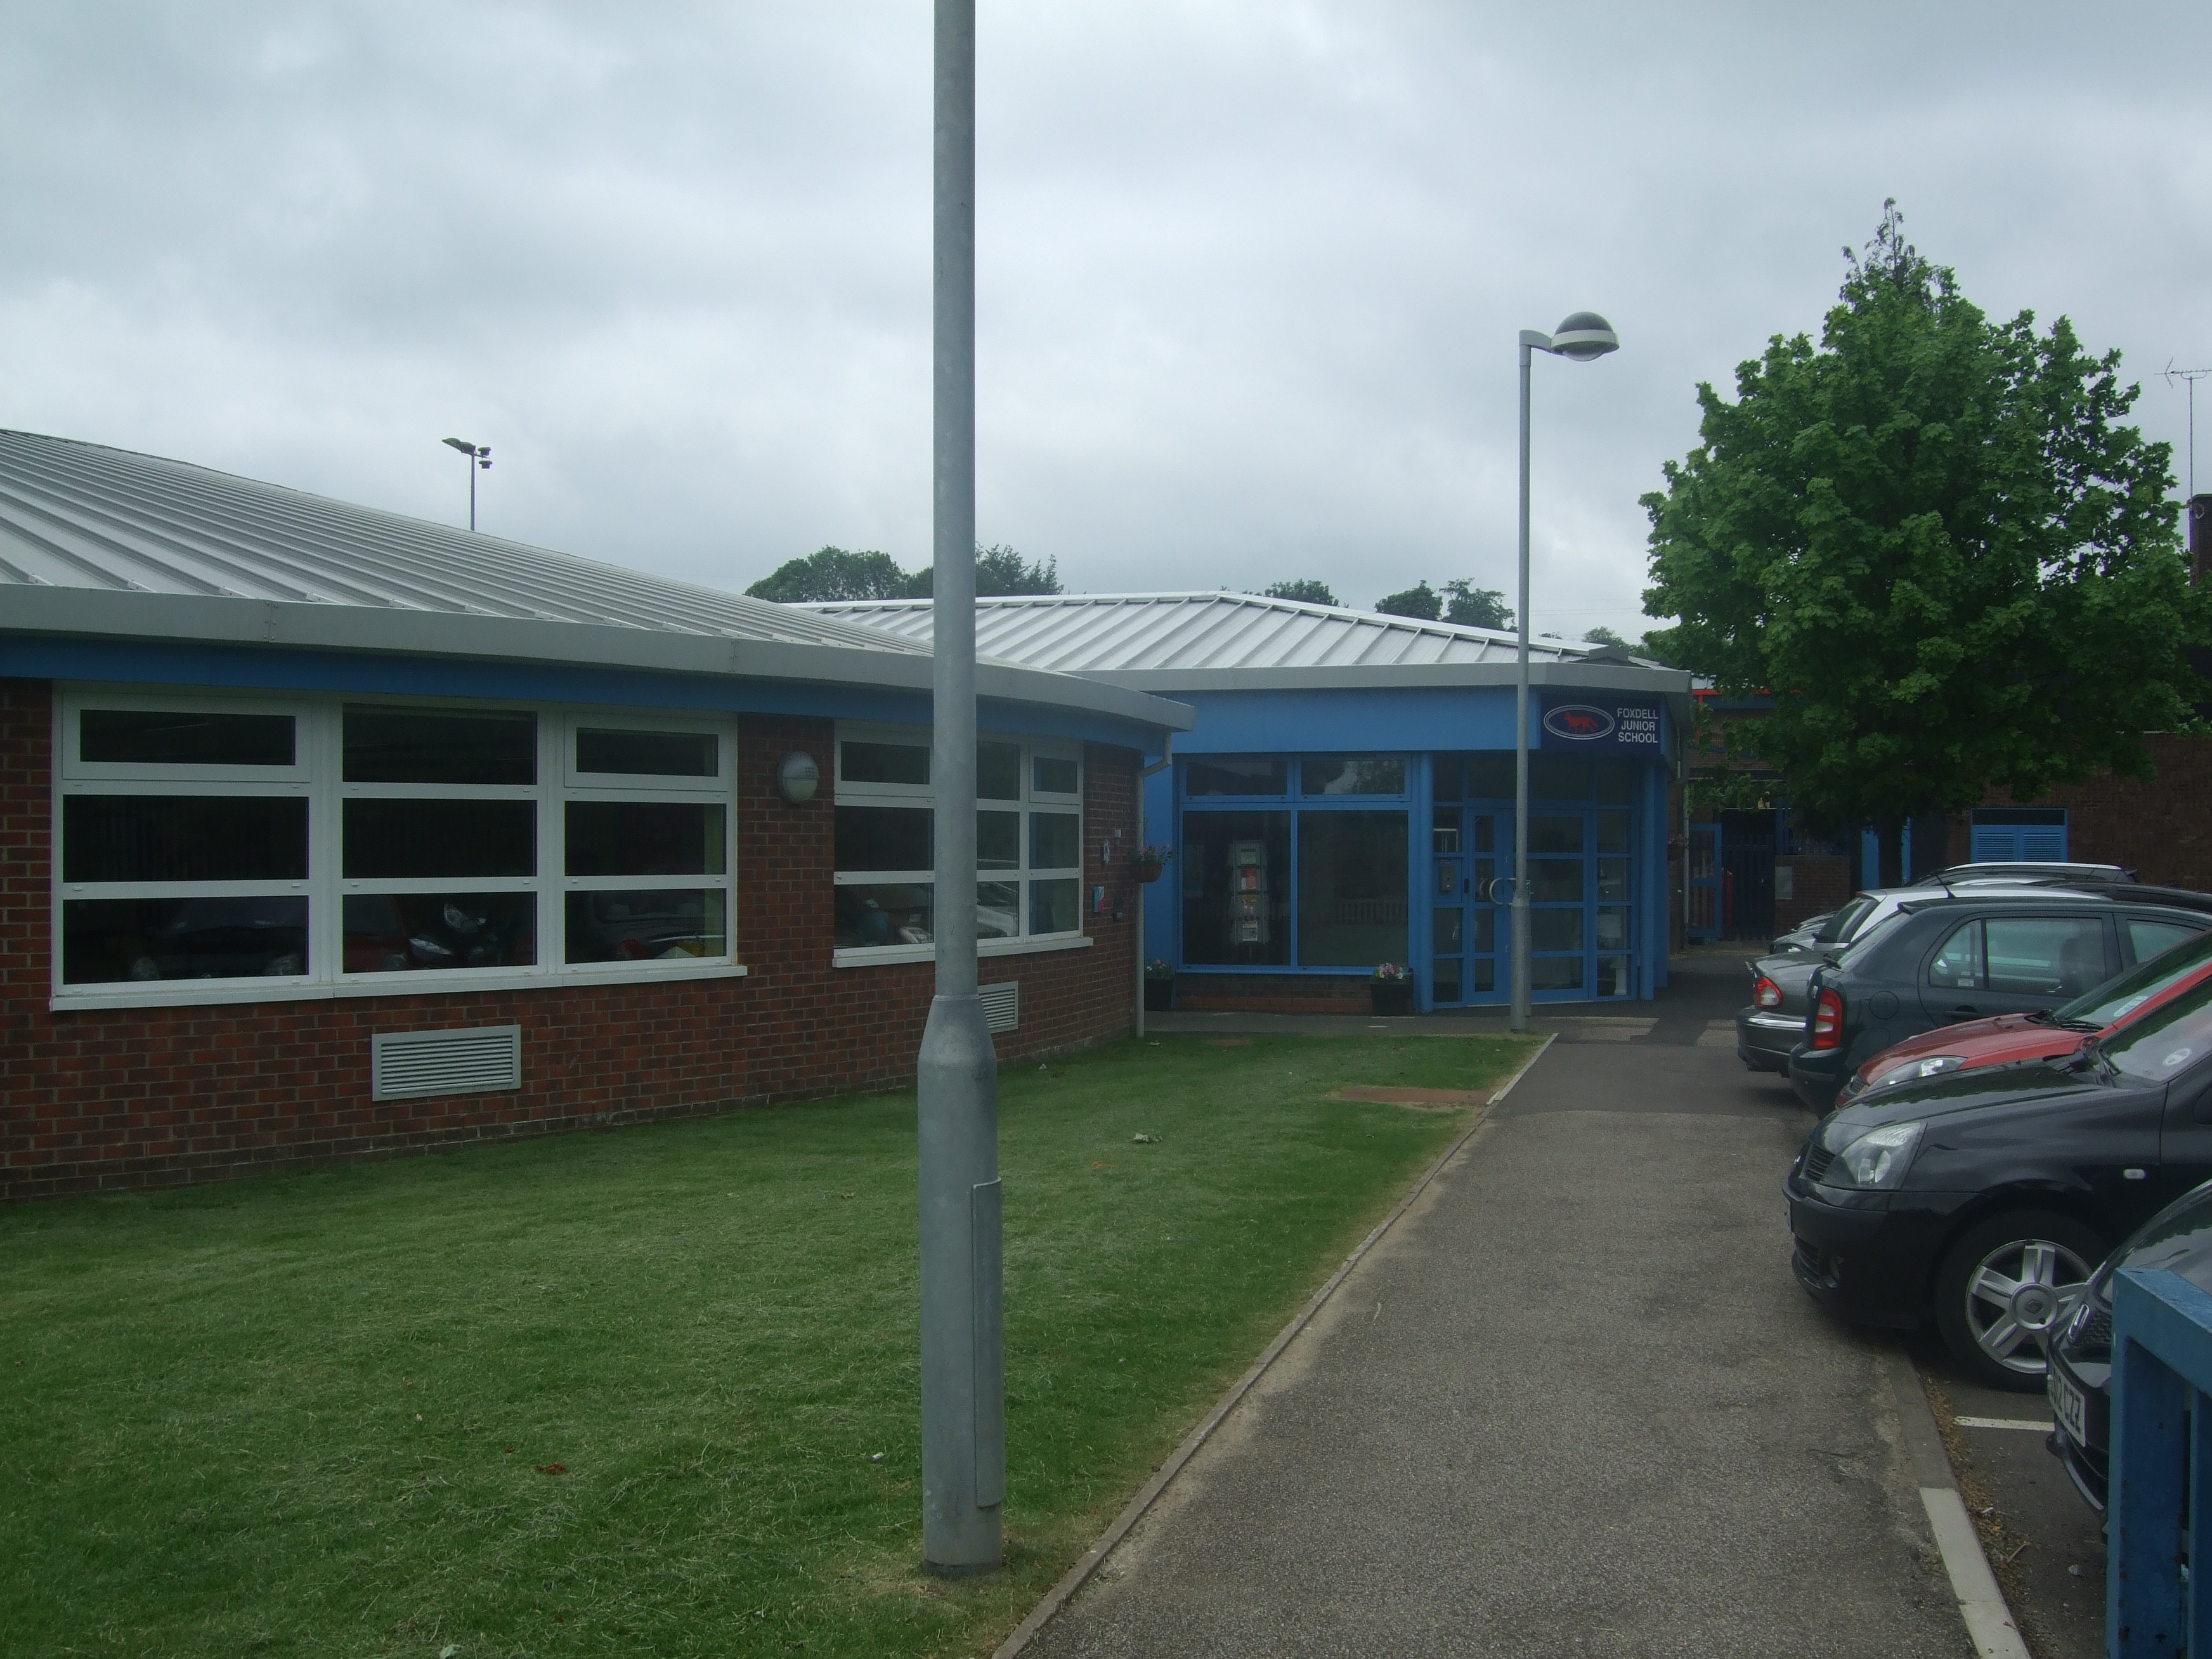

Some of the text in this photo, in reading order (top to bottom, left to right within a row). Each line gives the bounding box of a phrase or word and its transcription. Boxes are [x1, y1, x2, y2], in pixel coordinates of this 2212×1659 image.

[1617, 708, 1658, 719] FOXDELL
[1621, 720, 1655, 731] JUNIOR
[1618, 732, 1658, 743] SCHOOL
